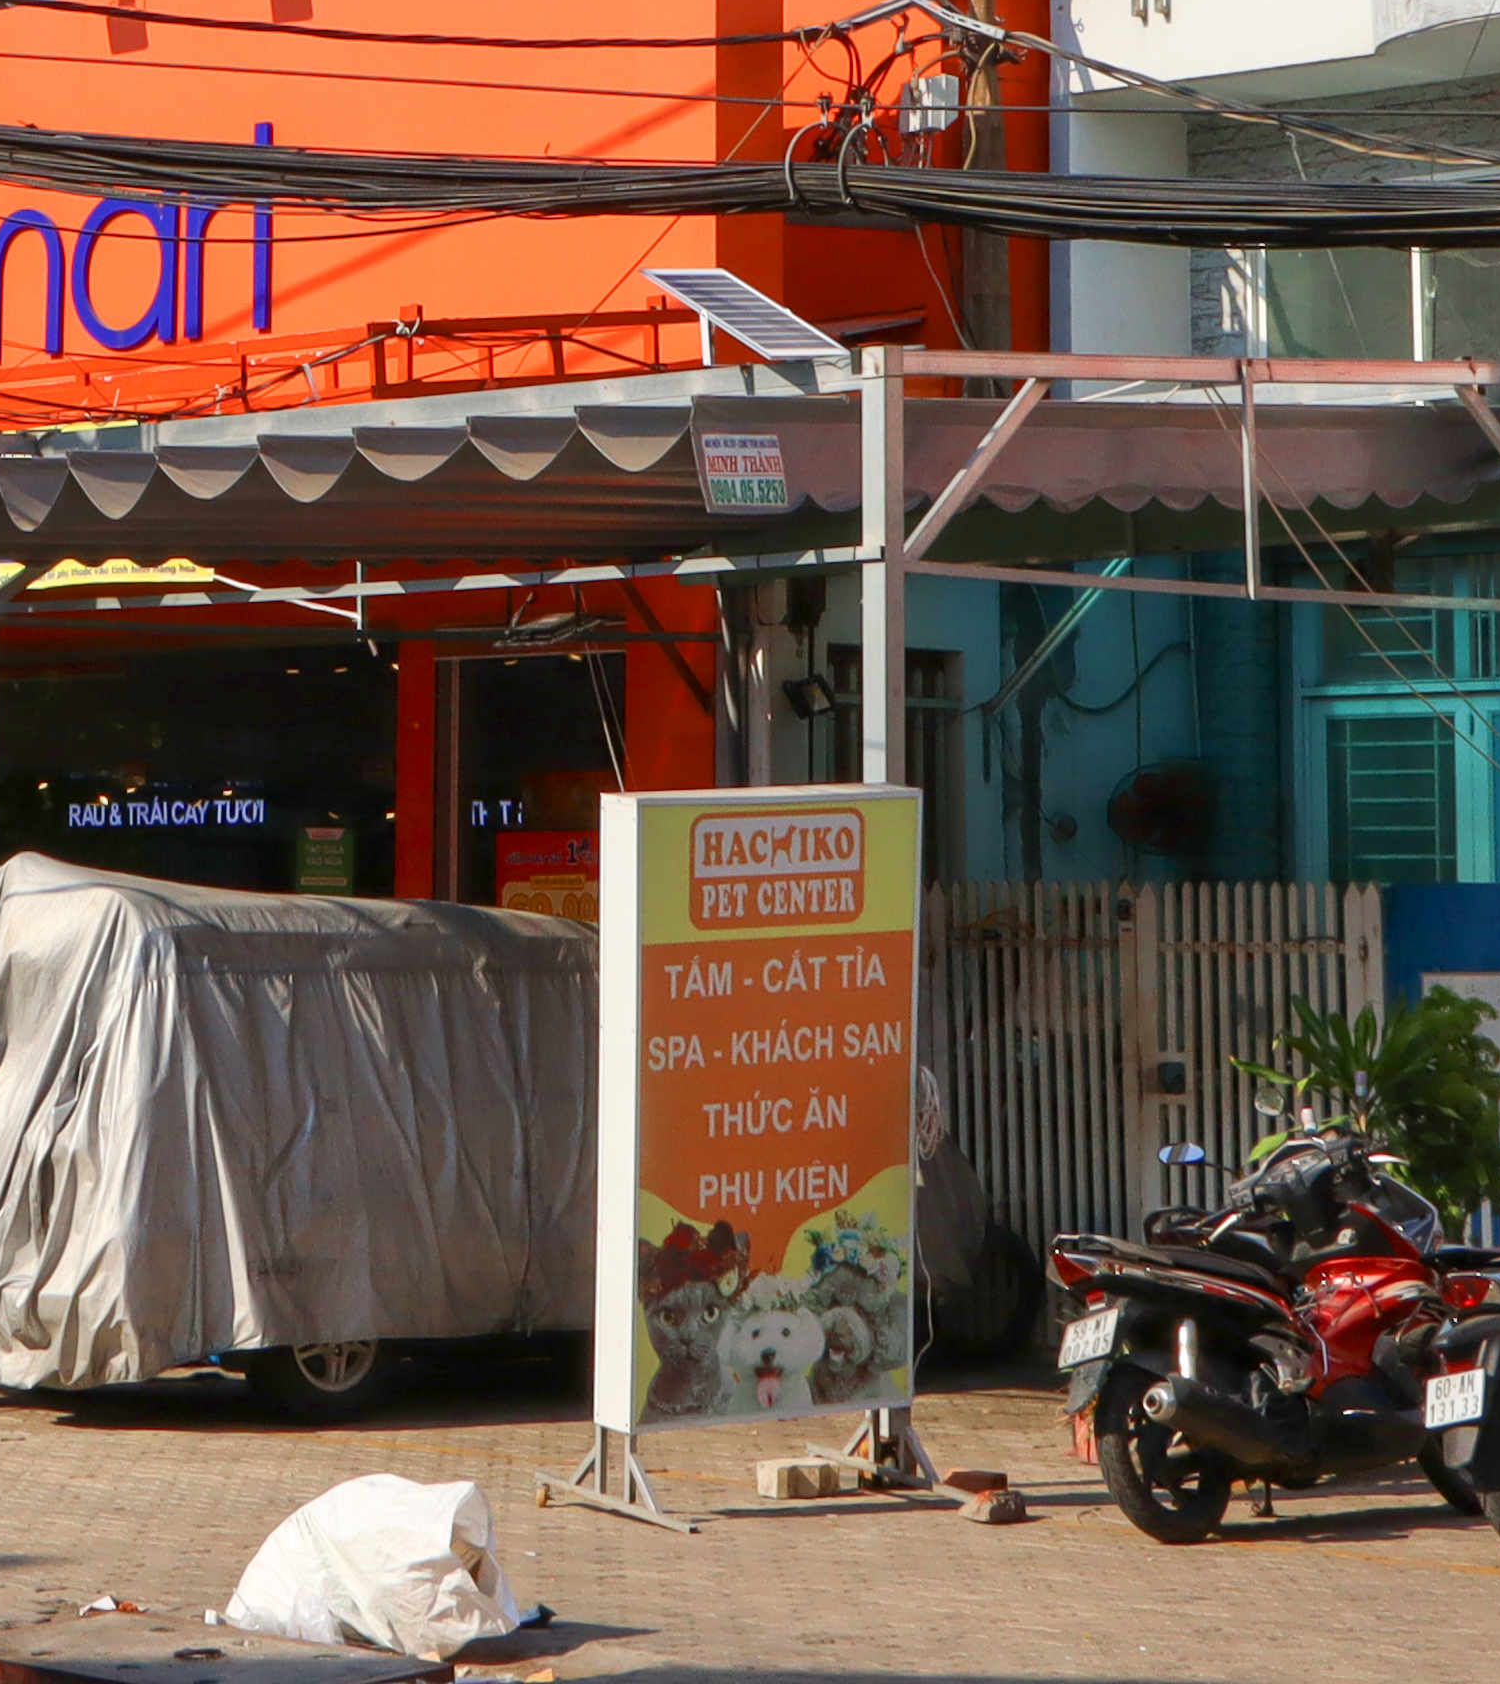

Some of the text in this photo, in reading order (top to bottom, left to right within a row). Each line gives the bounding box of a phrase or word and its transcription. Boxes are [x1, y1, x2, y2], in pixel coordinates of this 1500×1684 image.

[109, 801, 122, 826] &
[127, 796, 168, 826] TRÁI
[702, 878, 855, 919] PET CENTER
[664, 954, 733, 999] TẮM
[763, 949, 827, 993] CẮT
[836, 946, 886, 989] TỈA
[649, 1033, 706, 1071] SPA
[731, 1018, 834, 1066] KHÁCH
[843, 1020, 902, 1065] SẠN
[703, 1086, 848, 1138] THỨC ĂN
[699, 1159, 849, 1214] PHỤ KIỆN
[1429, 1395, 1480, 1424] 131.33
